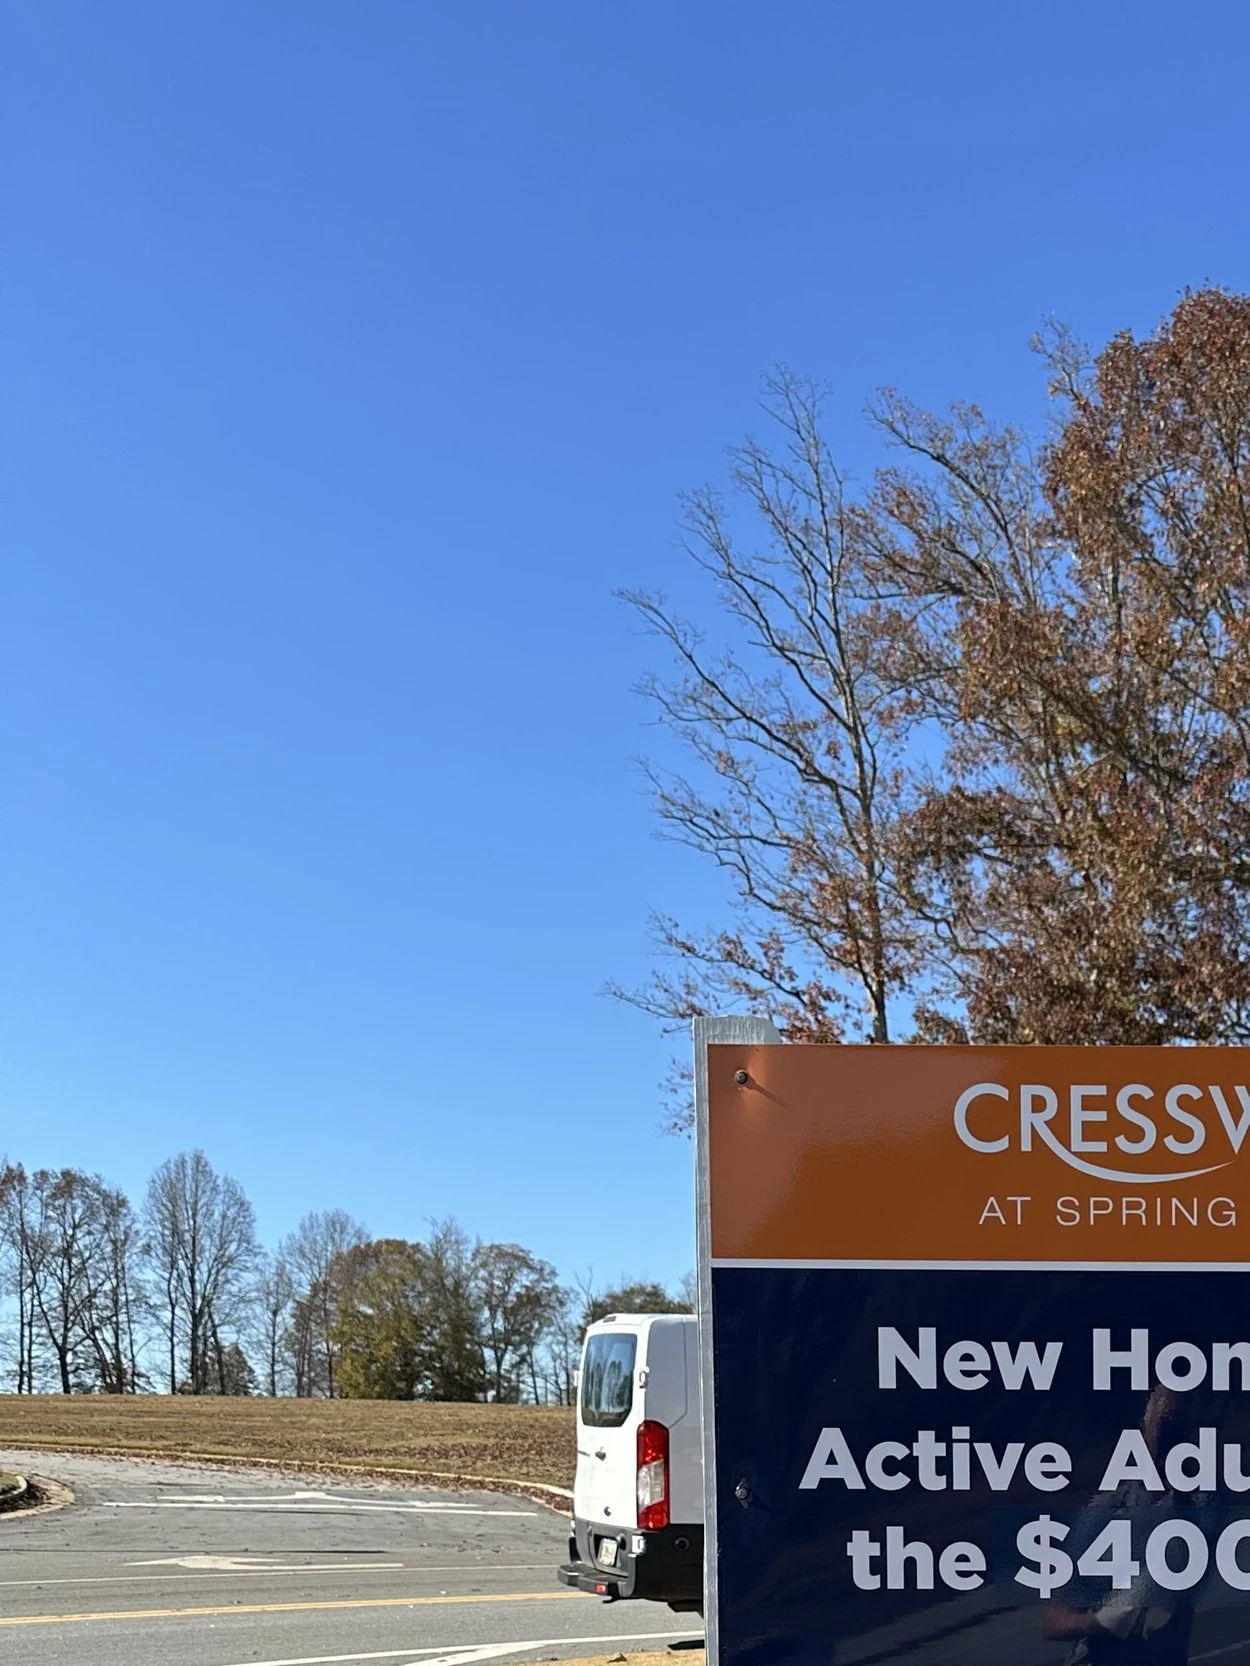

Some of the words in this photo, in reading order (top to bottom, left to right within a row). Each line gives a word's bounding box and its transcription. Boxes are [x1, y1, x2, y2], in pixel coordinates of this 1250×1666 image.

[978, 1196, 1032, 1225] AT
[1056, 1196, 1236, 1227] SPRING
[877, 1326, 1064, 1391] New
[798, 1426, 1073, 1492] Active
[846, 1525, 988, 1591] the
